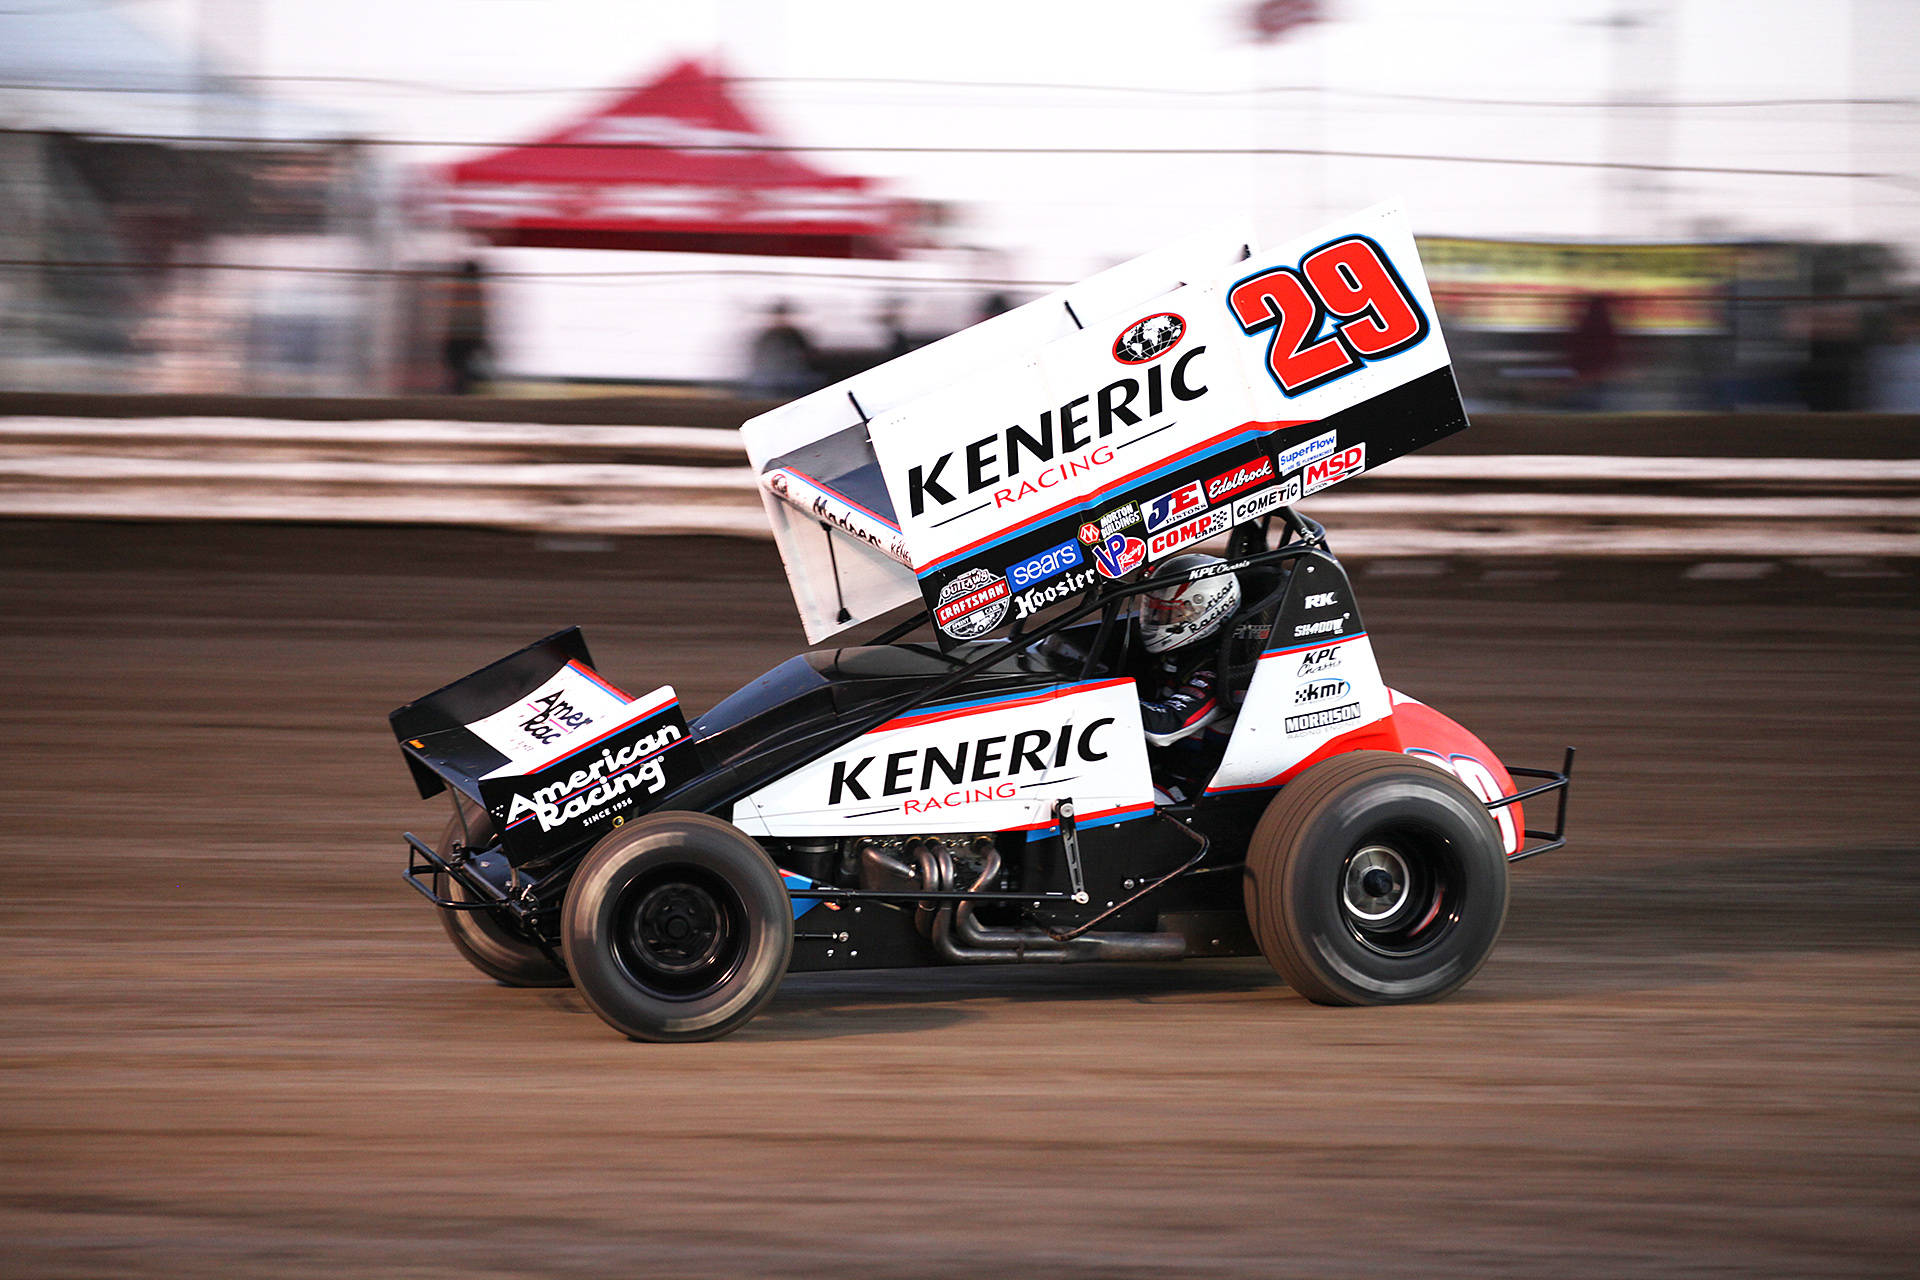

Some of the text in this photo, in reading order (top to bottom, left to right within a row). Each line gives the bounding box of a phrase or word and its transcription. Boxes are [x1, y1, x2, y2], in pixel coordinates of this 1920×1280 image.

[1226, 233, 1431, 399] 29
[908, 345, 1209, 518] KENERIC
[1280, 435, 1335, 466] SuperFlow
[1306, 447, 1362, 486] MSD
[993, 445, 1115, 509] RACING
[1208, 460, 1273, 499] Edelbrock
[1100, 503, 1134, 528] MORTON
[1148, 483, 1199, 531] JE
[1166, 504, 1207, 525] PISTONS
[1100, 511, 1140, 539] BUILDINGS
[1152, 515, 1212, 554] COMP
[1195, 522, 1224, 539] CAMS
[1013, 545, 1077, 585] sears
[1093, 533, 1127, 577] VP
[941, 570, 988, 598] OUTLAWS
[1189, 567, 1217, 581] KPC
[939, 583, 1005, 621] CRAFTSMAN
[1014, 568, 1095, 619] Hoosier
[1305, 592, 1338, 609] RK
[1294, 618, 1344, 637] SHADOW
[1303, 646, 1341, 664] KPC
[1307, 681, 1345, 700] kmr
[1286, 703, 1361, 733] MORRISON
[506, 724, 682, 825] American
[828, 717, 1115, 805] KENERIC
[534, 757, 666, 833] Racing
[582, 797, 634, 827] SINCE 1956
[904, 782, 1016, 815] RACING
